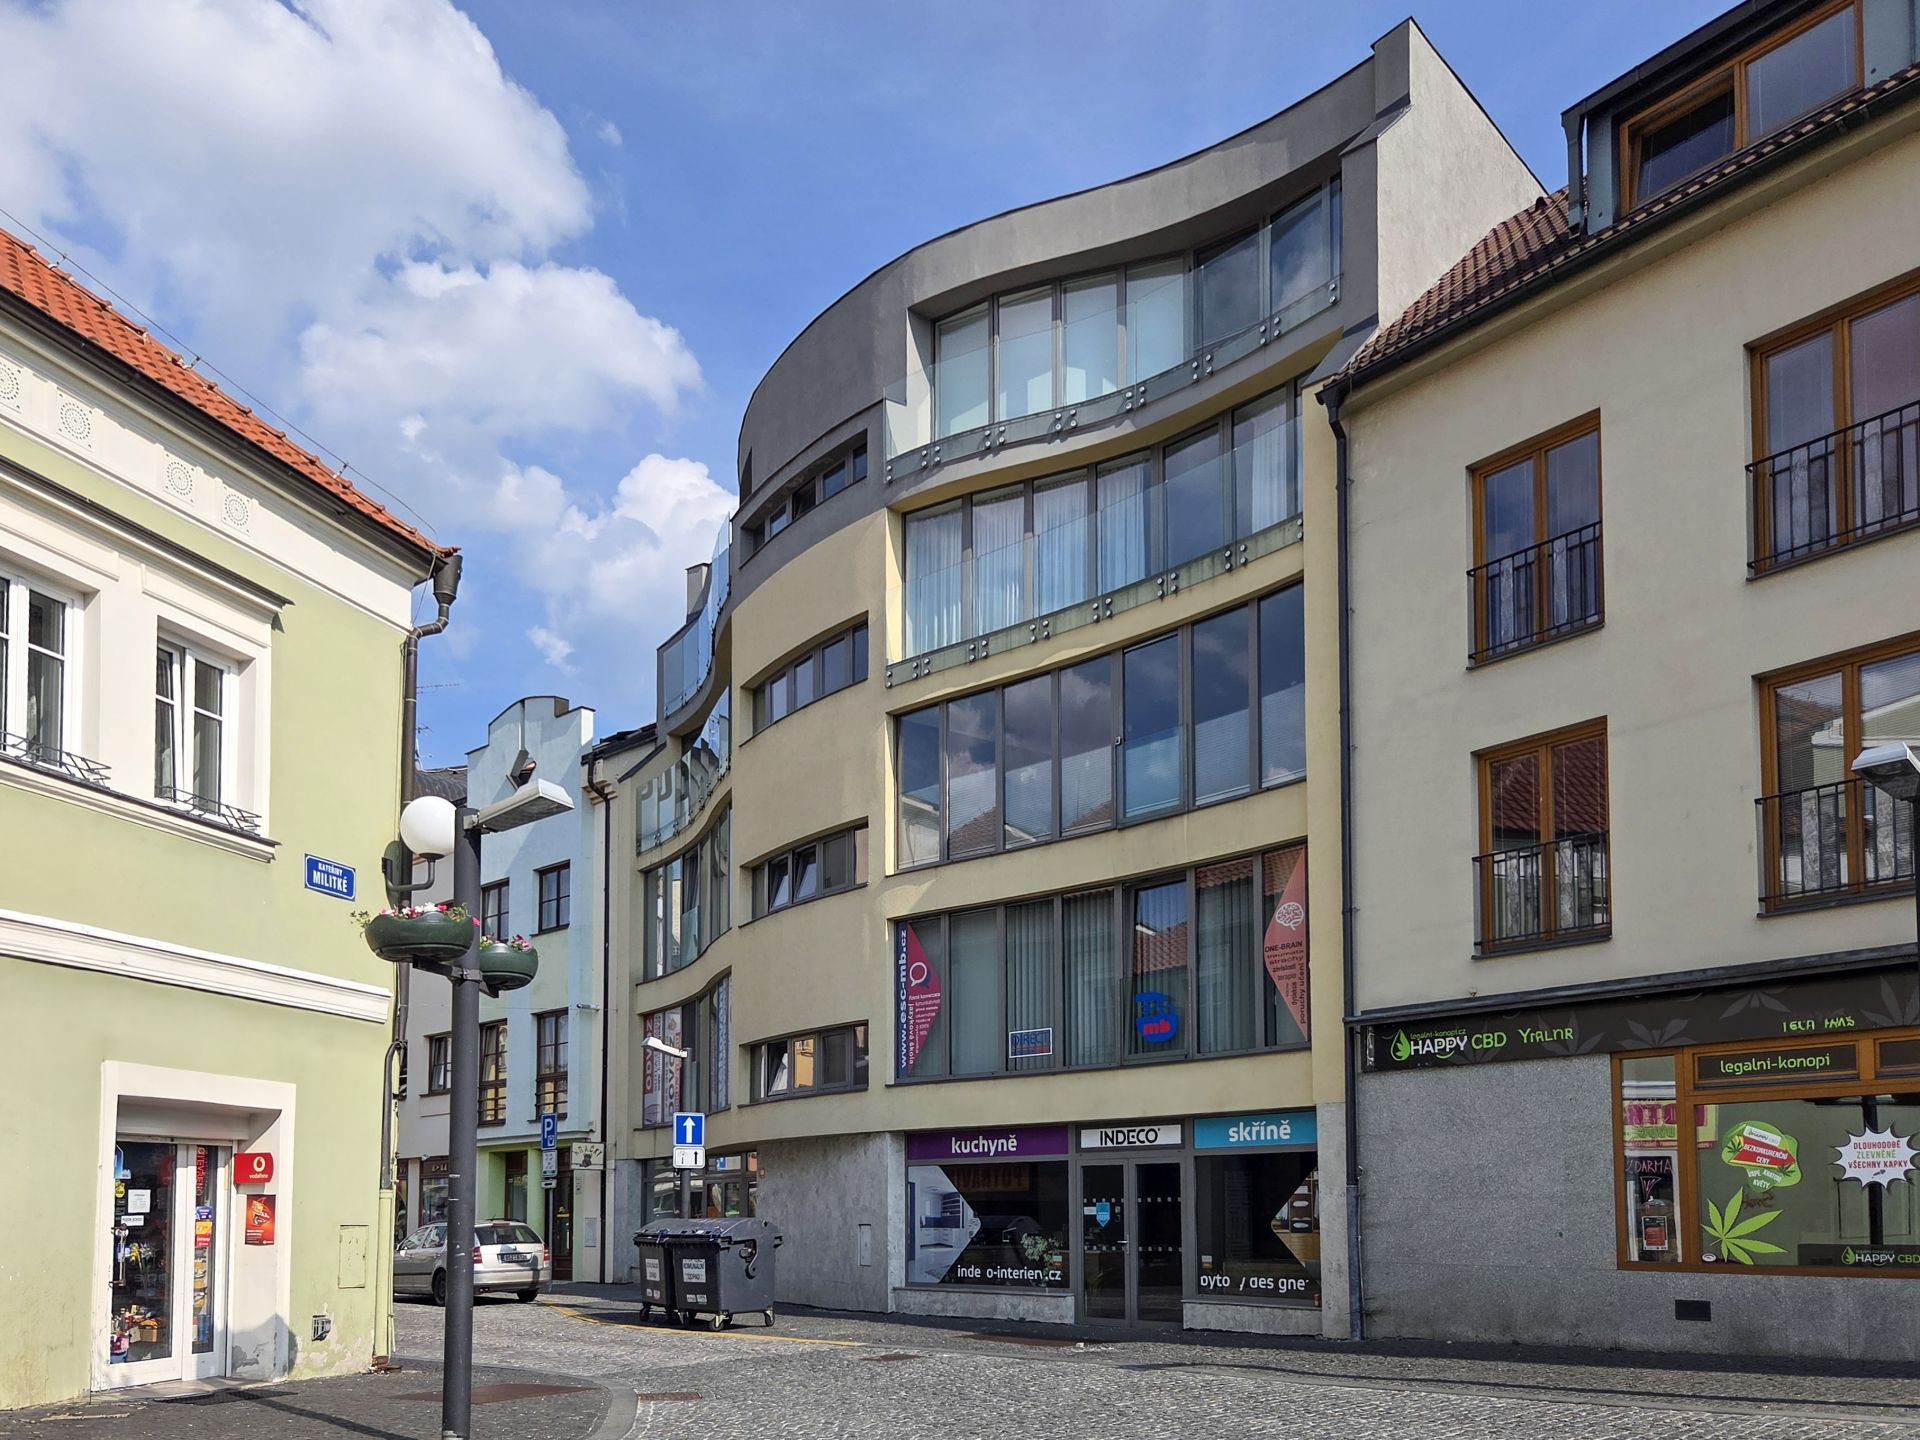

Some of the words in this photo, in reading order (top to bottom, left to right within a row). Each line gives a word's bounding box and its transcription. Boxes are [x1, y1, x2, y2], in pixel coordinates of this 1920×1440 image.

[318, 862, 342, 876] KATEŘINY
[313, 870, 348, 892] MILITKÉ
[1265, 941, 1303, 953] ONE-BRAIN
[899, 930, 907, 1068] www.esc-mb.cz
[645, 1016, 653, 1090] ODVZ
[1410, 1036, 1468, 1056] HAPPY
[1471, 1032, 1507, 1050] CBD
[1720, 1053, 1830, 1075] legalni-konopi
[544, 1118, 553, 1138] P
[1100, 1128, 1158, 1146] INDECO
[1228, 1120, 1291, 1142] skříně
[951, 1134, 1018, 1156] kuchyně
[1853, 1140, 1901, 1150] DLOUHODOBĚ
[1848, 1160, 1881, 1169] VŠECHNY
[1883, 1159, 1908, 1168] KAPKY
[1855, 1254, 1895, 1263] HAPPY
[1897, 1254, 1920, 1263] CBD
